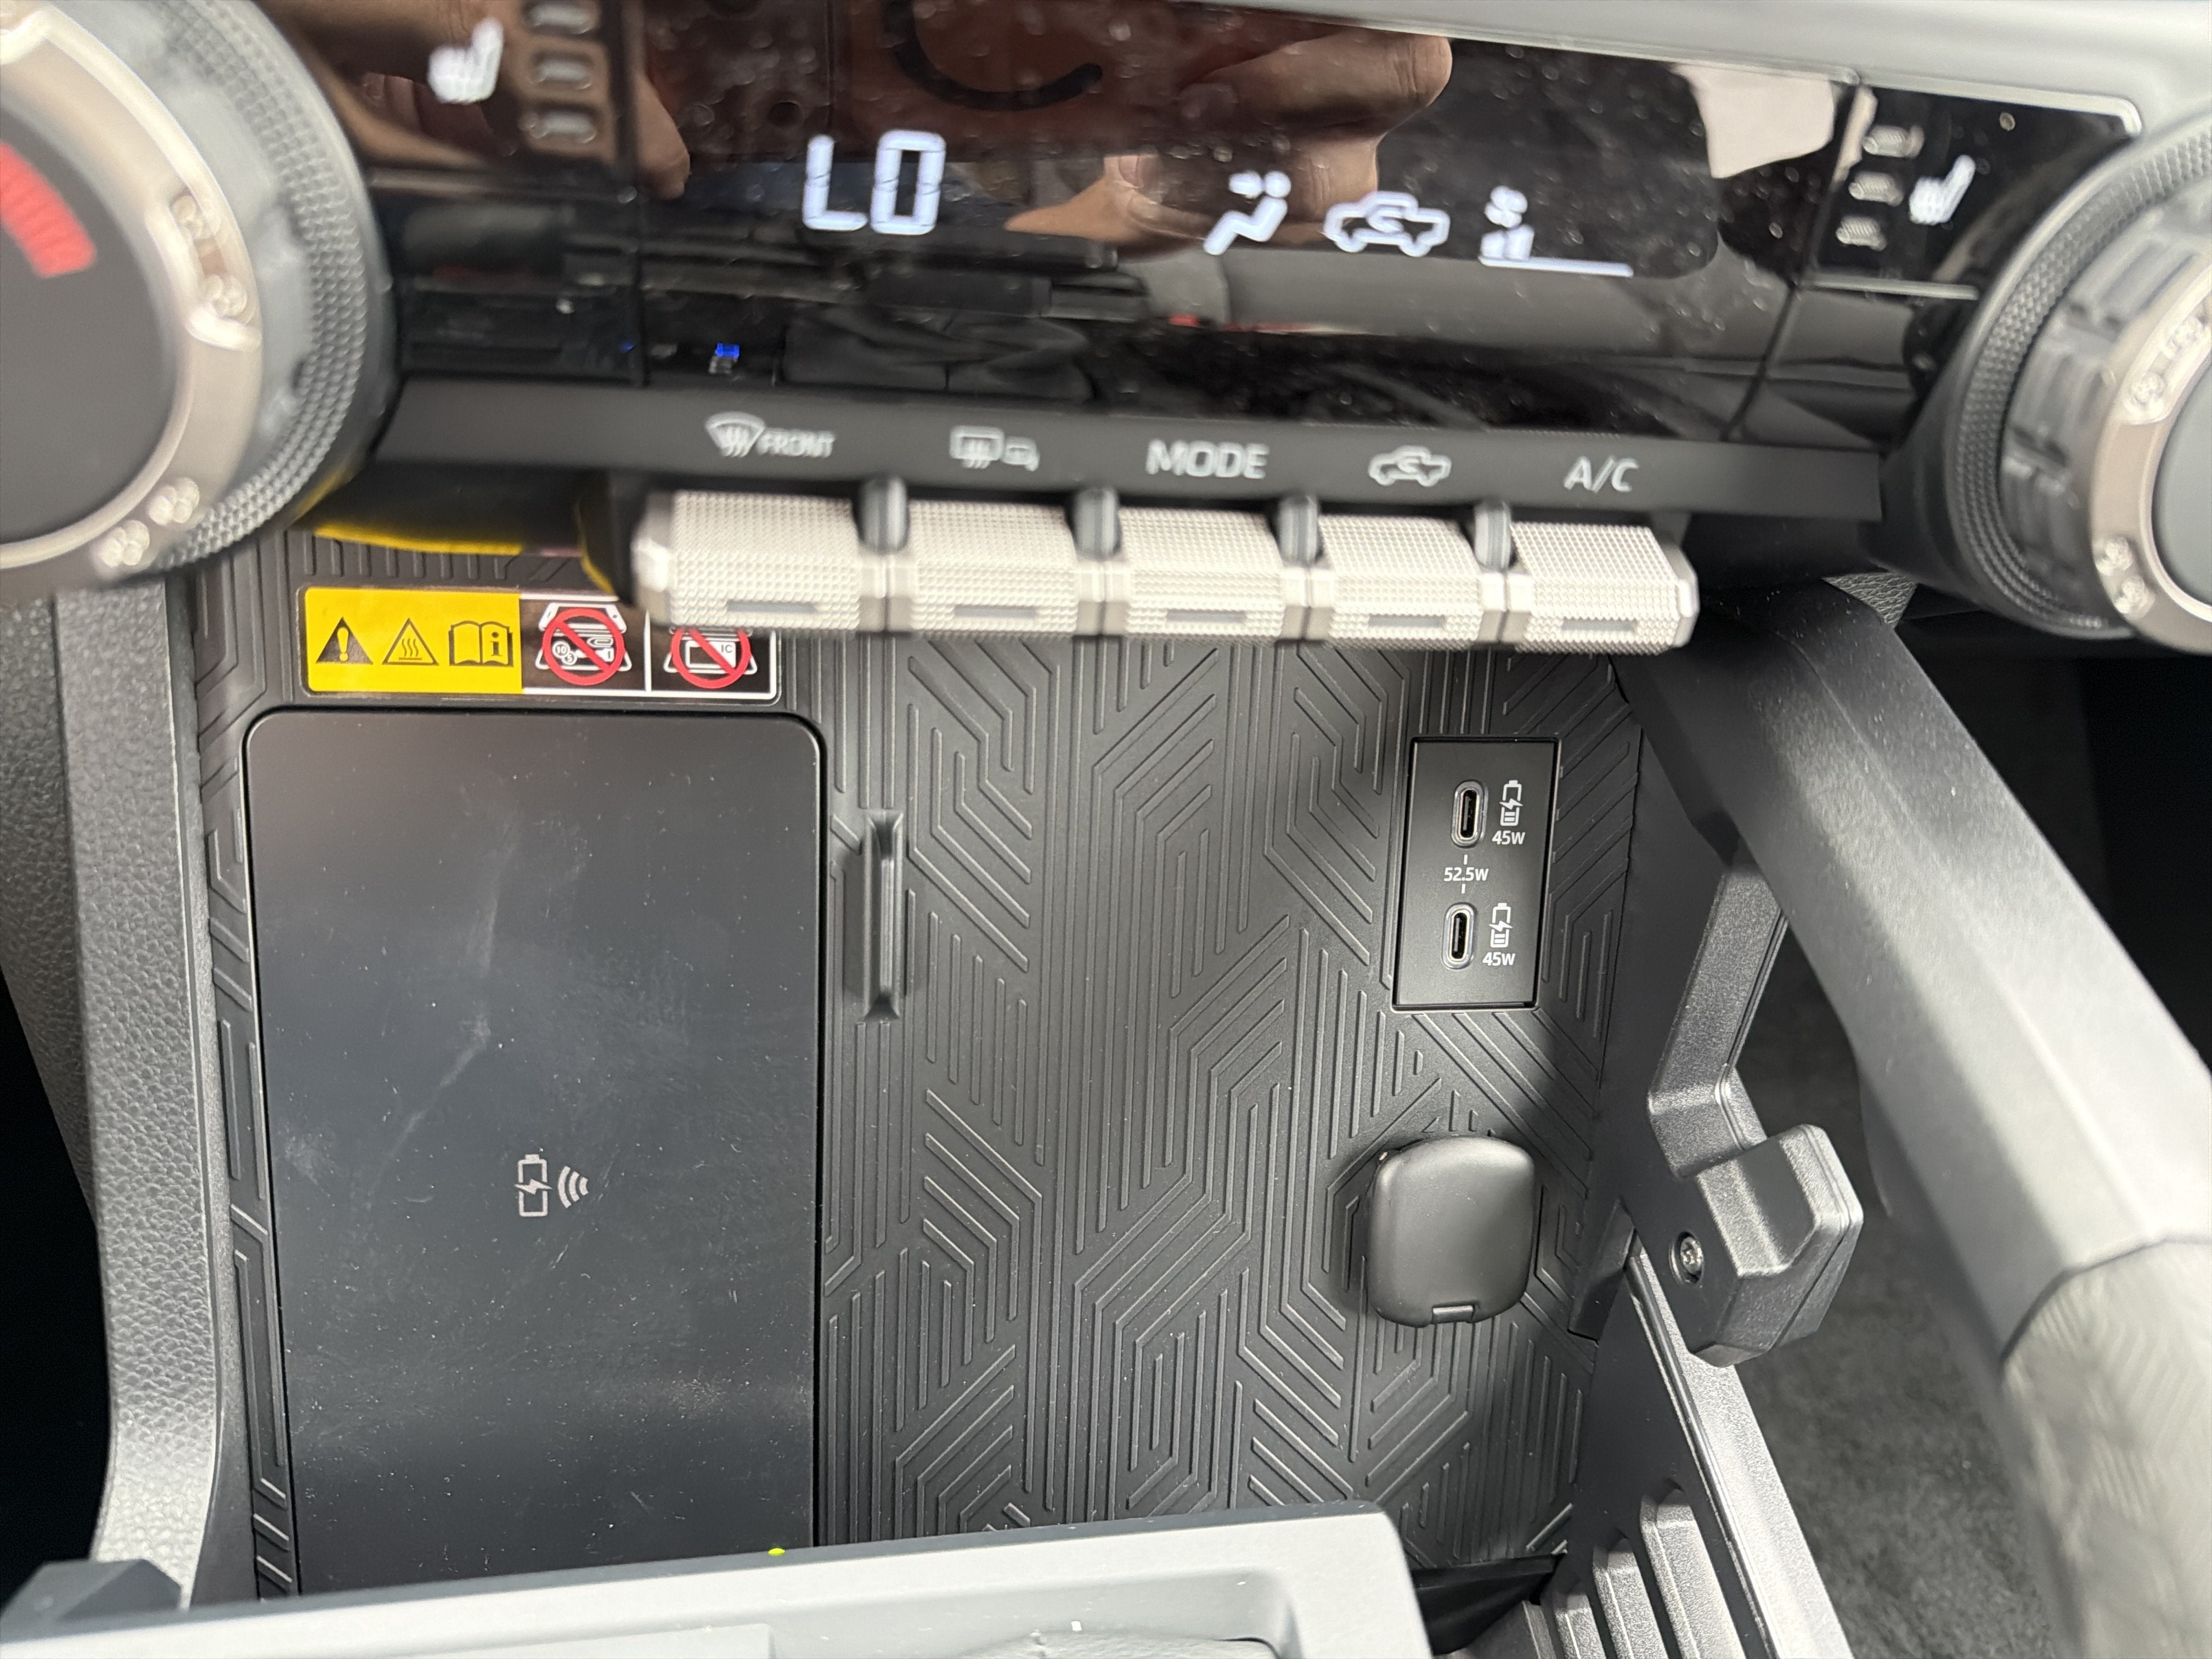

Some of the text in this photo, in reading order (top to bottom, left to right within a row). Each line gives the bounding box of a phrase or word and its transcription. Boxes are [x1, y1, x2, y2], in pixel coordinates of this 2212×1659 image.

[756, 428, 836, 458] FRONT
[1146, 439, 1269, 478] MODE
[1564, 455, 1639, 493] A/C
[556, 646, 567, 654] 10
[721, 644, 733, 653] IC
[1492, 830, 1525, 845] 45W
[1443, 867, 1489, 882] 52.5W
[1482, 952, 1515, 966] 45W
